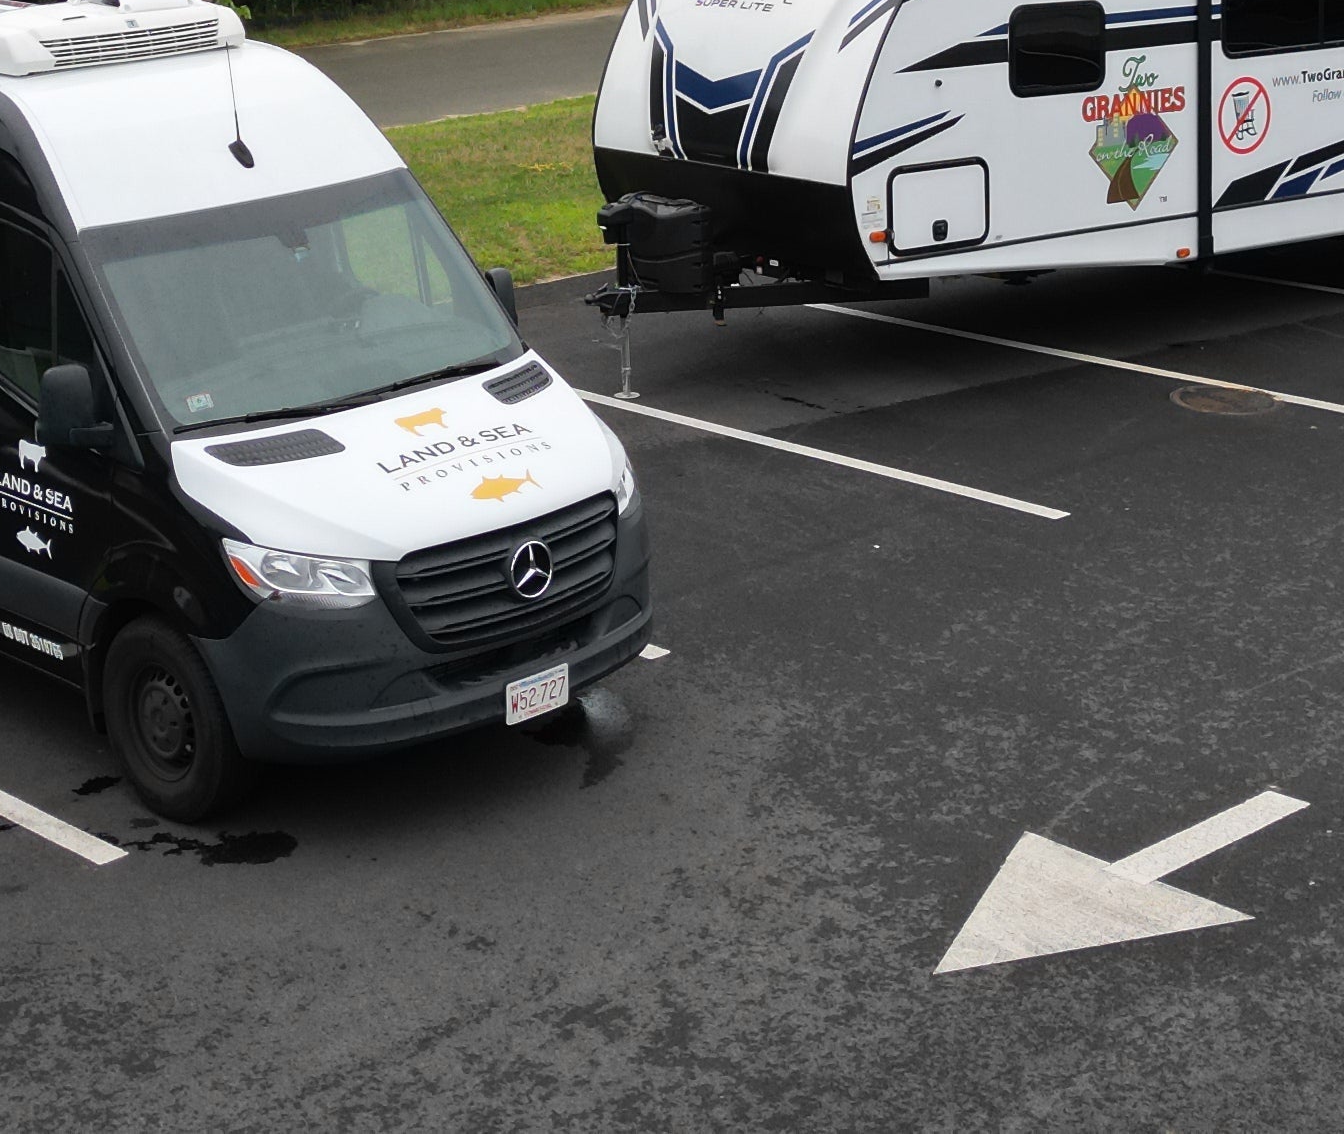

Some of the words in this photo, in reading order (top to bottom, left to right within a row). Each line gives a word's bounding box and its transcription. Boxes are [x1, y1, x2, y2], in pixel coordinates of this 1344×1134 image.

[740, 1, 774, 12] LITE
[1119, 54, 1158, 92] Two
[1081, 86, 1186, 123] GRANNIES
[1312, 88, 1341, 103] Follow
[1096, 151, 1110, 162] on
[1113, 140, 1133, 159] the
[1137, 133, 1173, 158] Road
[376, 441, 456, 474] LAND
[457, 435, 480, 447] &
[478, 423, 533, 442] SEA
[400, 441, 552, 492] PROVISIONS
[33, 483, 43, 501] &
[45, 488, 73, 513] SEA
